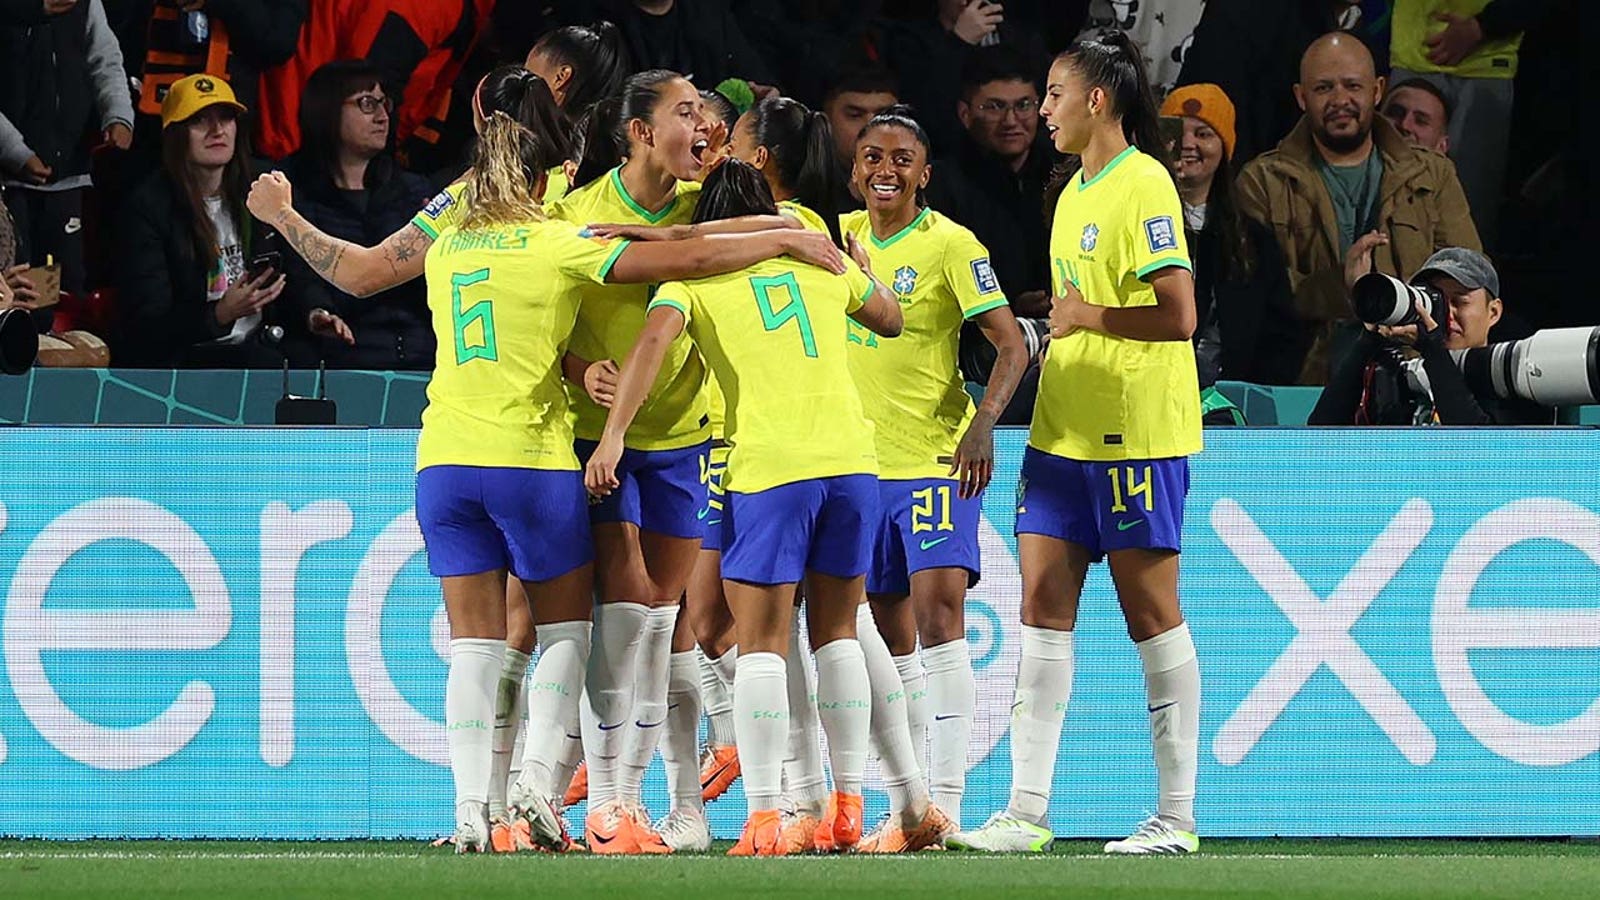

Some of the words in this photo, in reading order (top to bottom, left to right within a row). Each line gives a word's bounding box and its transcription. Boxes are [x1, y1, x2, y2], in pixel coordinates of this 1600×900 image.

[450, 267, 498, 366] 6
[749, 271, 819, 358] 9
[911, 485, 954, 535] 21
[1107, 465, 1154, 513] 14
